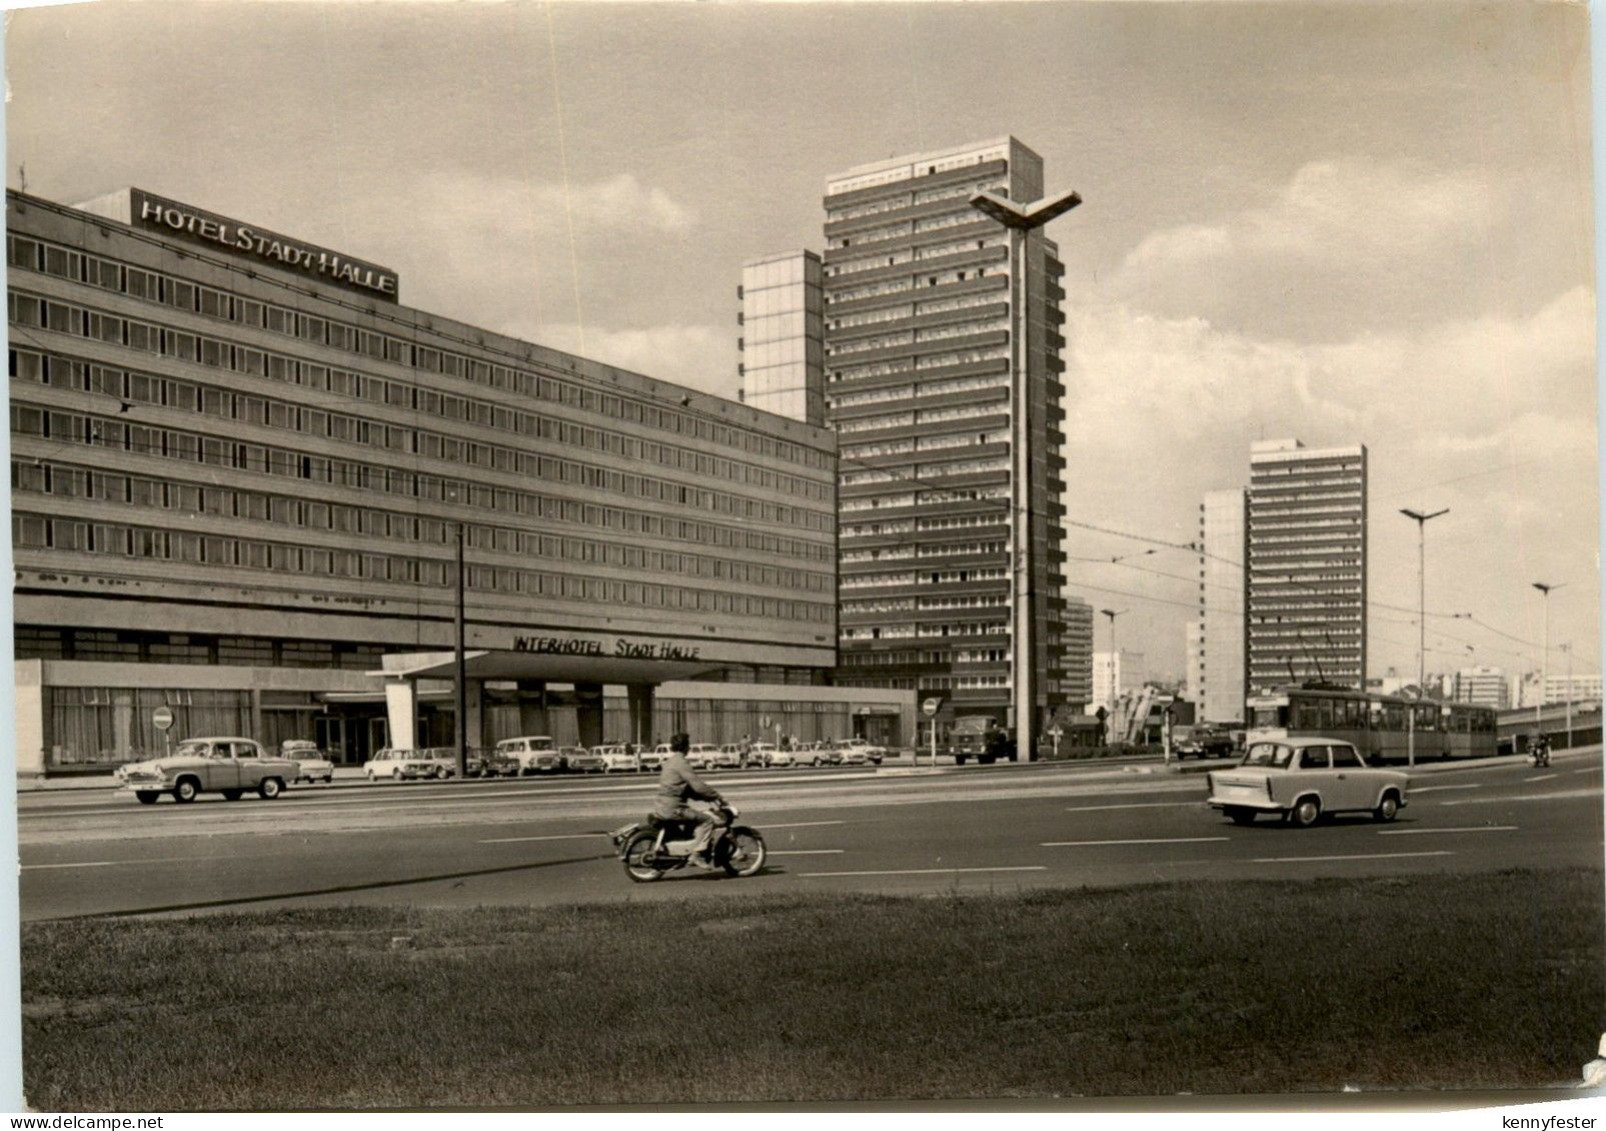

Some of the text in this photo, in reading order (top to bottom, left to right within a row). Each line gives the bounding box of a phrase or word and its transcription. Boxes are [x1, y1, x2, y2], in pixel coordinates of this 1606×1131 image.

[141, 201, 395, 294] HOTEL STADT HALLE
[513, 636, 605, 655] INTERHOTEL
